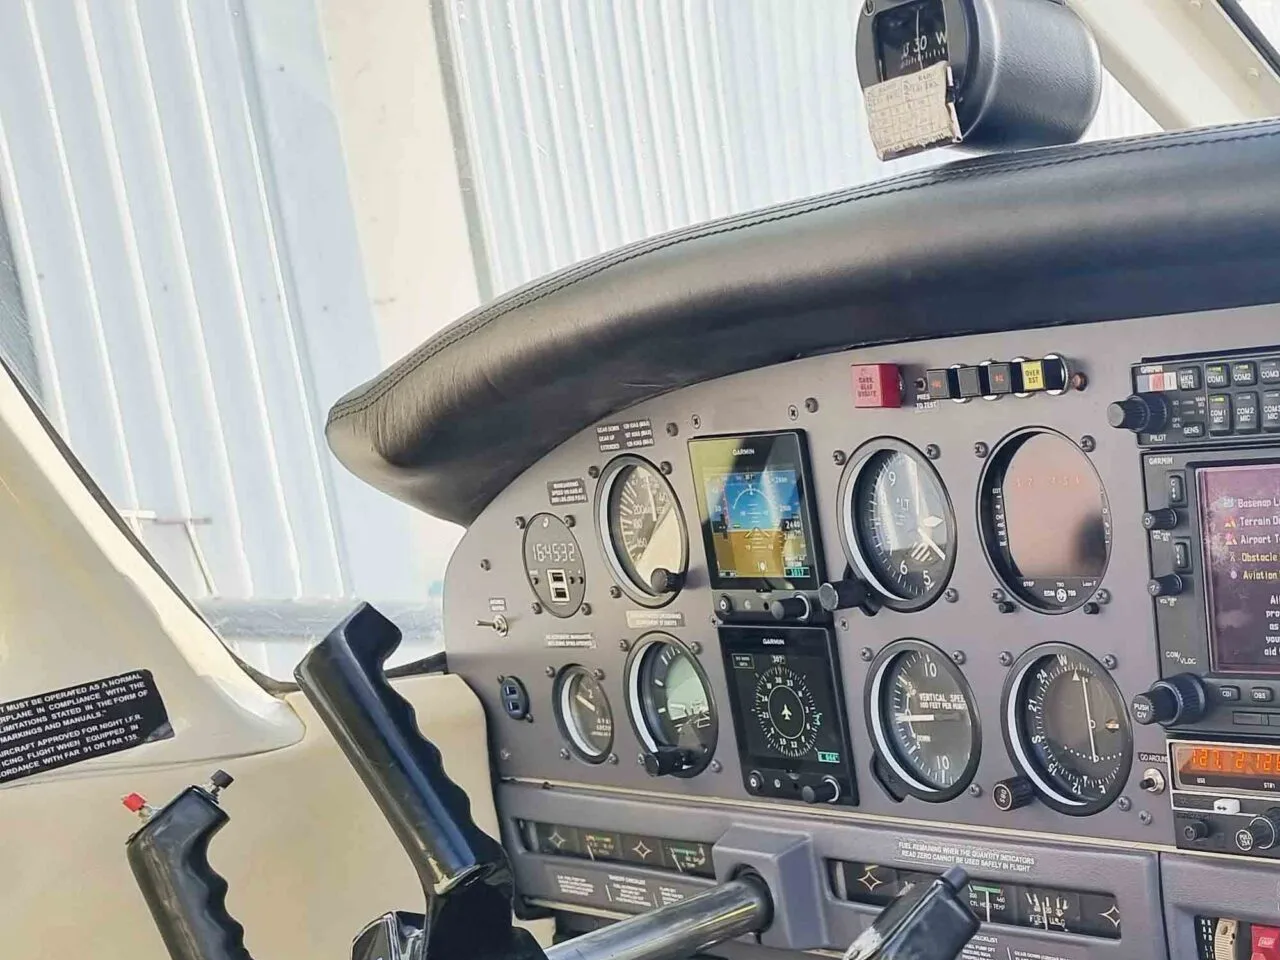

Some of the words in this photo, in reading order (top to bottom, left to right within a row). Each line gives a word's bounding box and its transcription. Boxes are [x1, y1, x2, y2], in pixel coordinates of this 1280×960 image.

[1149, 457, 1173, 465] GARMIN
[1242, 552, 1277, 562] Obstacle
[1243, 571, 1277, 580] Aviation
[924, 663, 937, 678] 10
[7, 701, 29, 711] MUST
[32, 698, 42, 706] BE
[44, 687, 87, 702] OPERATED
[89, 684, 100, 692] AS
[108, 673, 142, 687] NORMAL
[48, 693, 100, 711] COMPLIANCE
[106, 687, 126, 696] WITH
[129, 682, 145, 690] THE
[919, 693, 946, 703] VERTICAL
